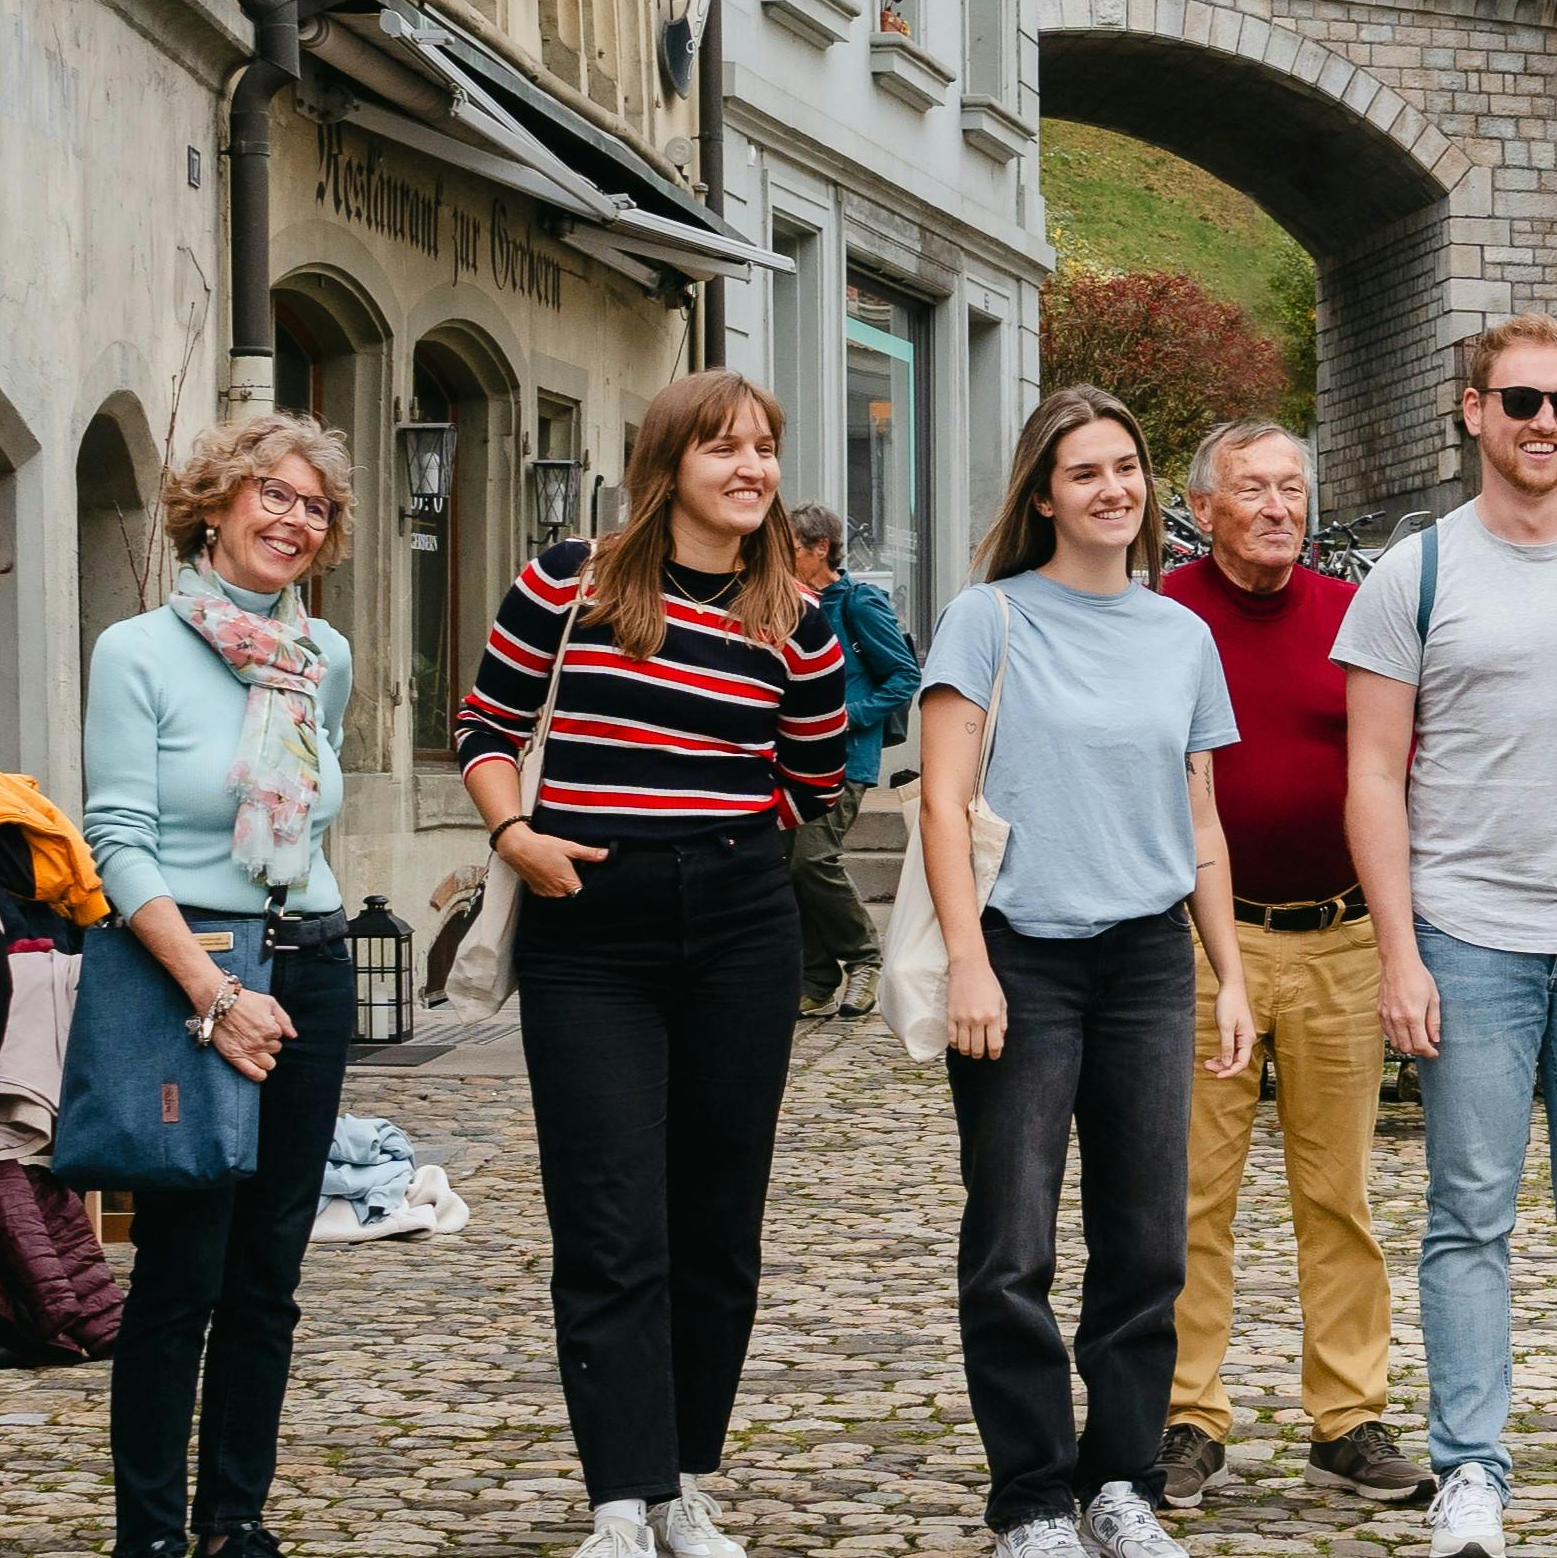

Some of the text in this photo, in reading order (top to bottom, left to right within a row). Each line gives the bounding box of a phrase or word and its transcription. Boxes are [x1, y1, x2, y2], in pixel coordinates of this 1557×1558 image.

[315, 122, 561, 313] Restaurant zur Gerbern
